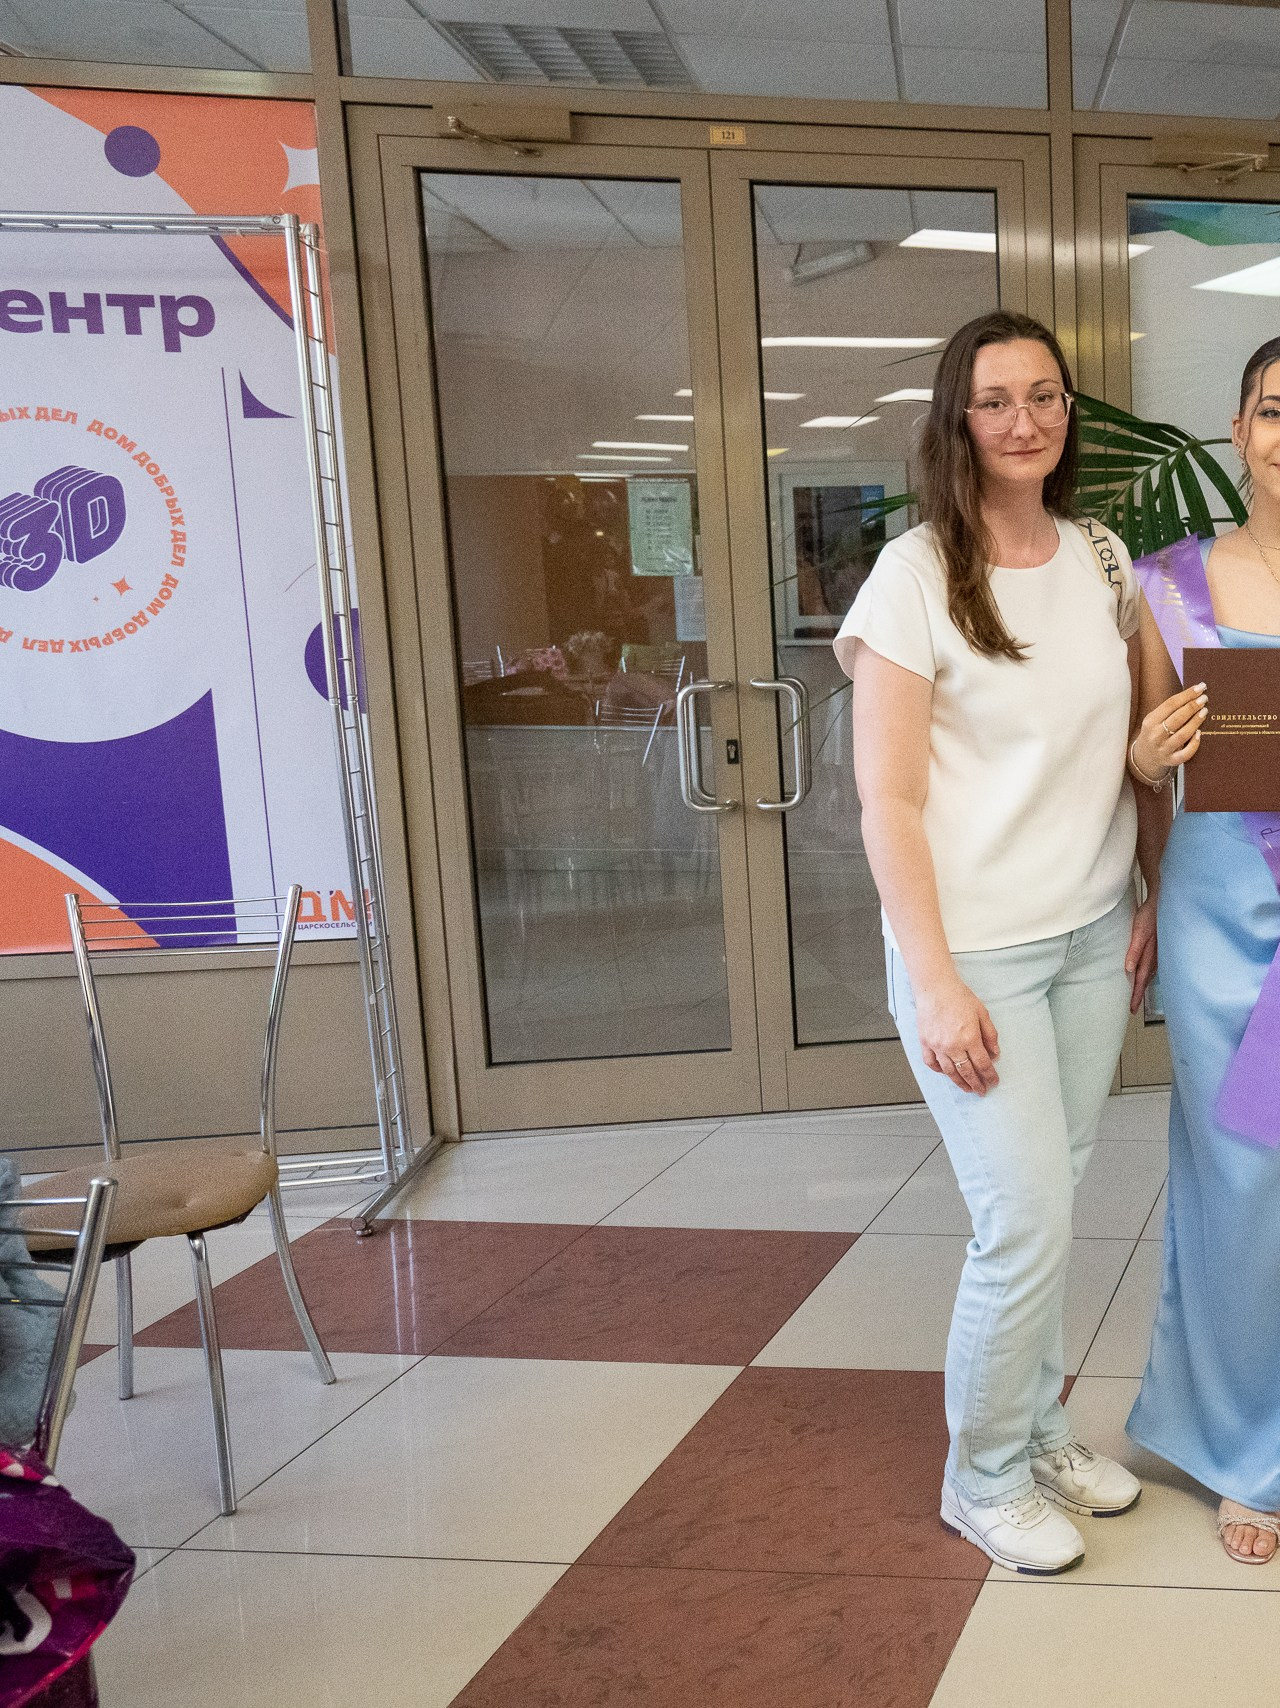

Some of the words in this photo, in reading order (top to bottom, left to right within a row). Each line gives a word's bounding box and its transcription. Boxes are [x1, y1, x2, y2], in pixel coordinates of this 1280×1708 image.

[34, 406, 78, 425] ДЕЛ
[86, 419, 138, 453] ДОМ
[132, 451, 186, 527] ДОБРЫХ
[170, 529, 187, 567] ДЕЛ
[146, 573, 179, 616] ДОМ
[22, 637, 65, 653] ДЕЛ
[68, 610, 150, 653] ДОБРЫХ
